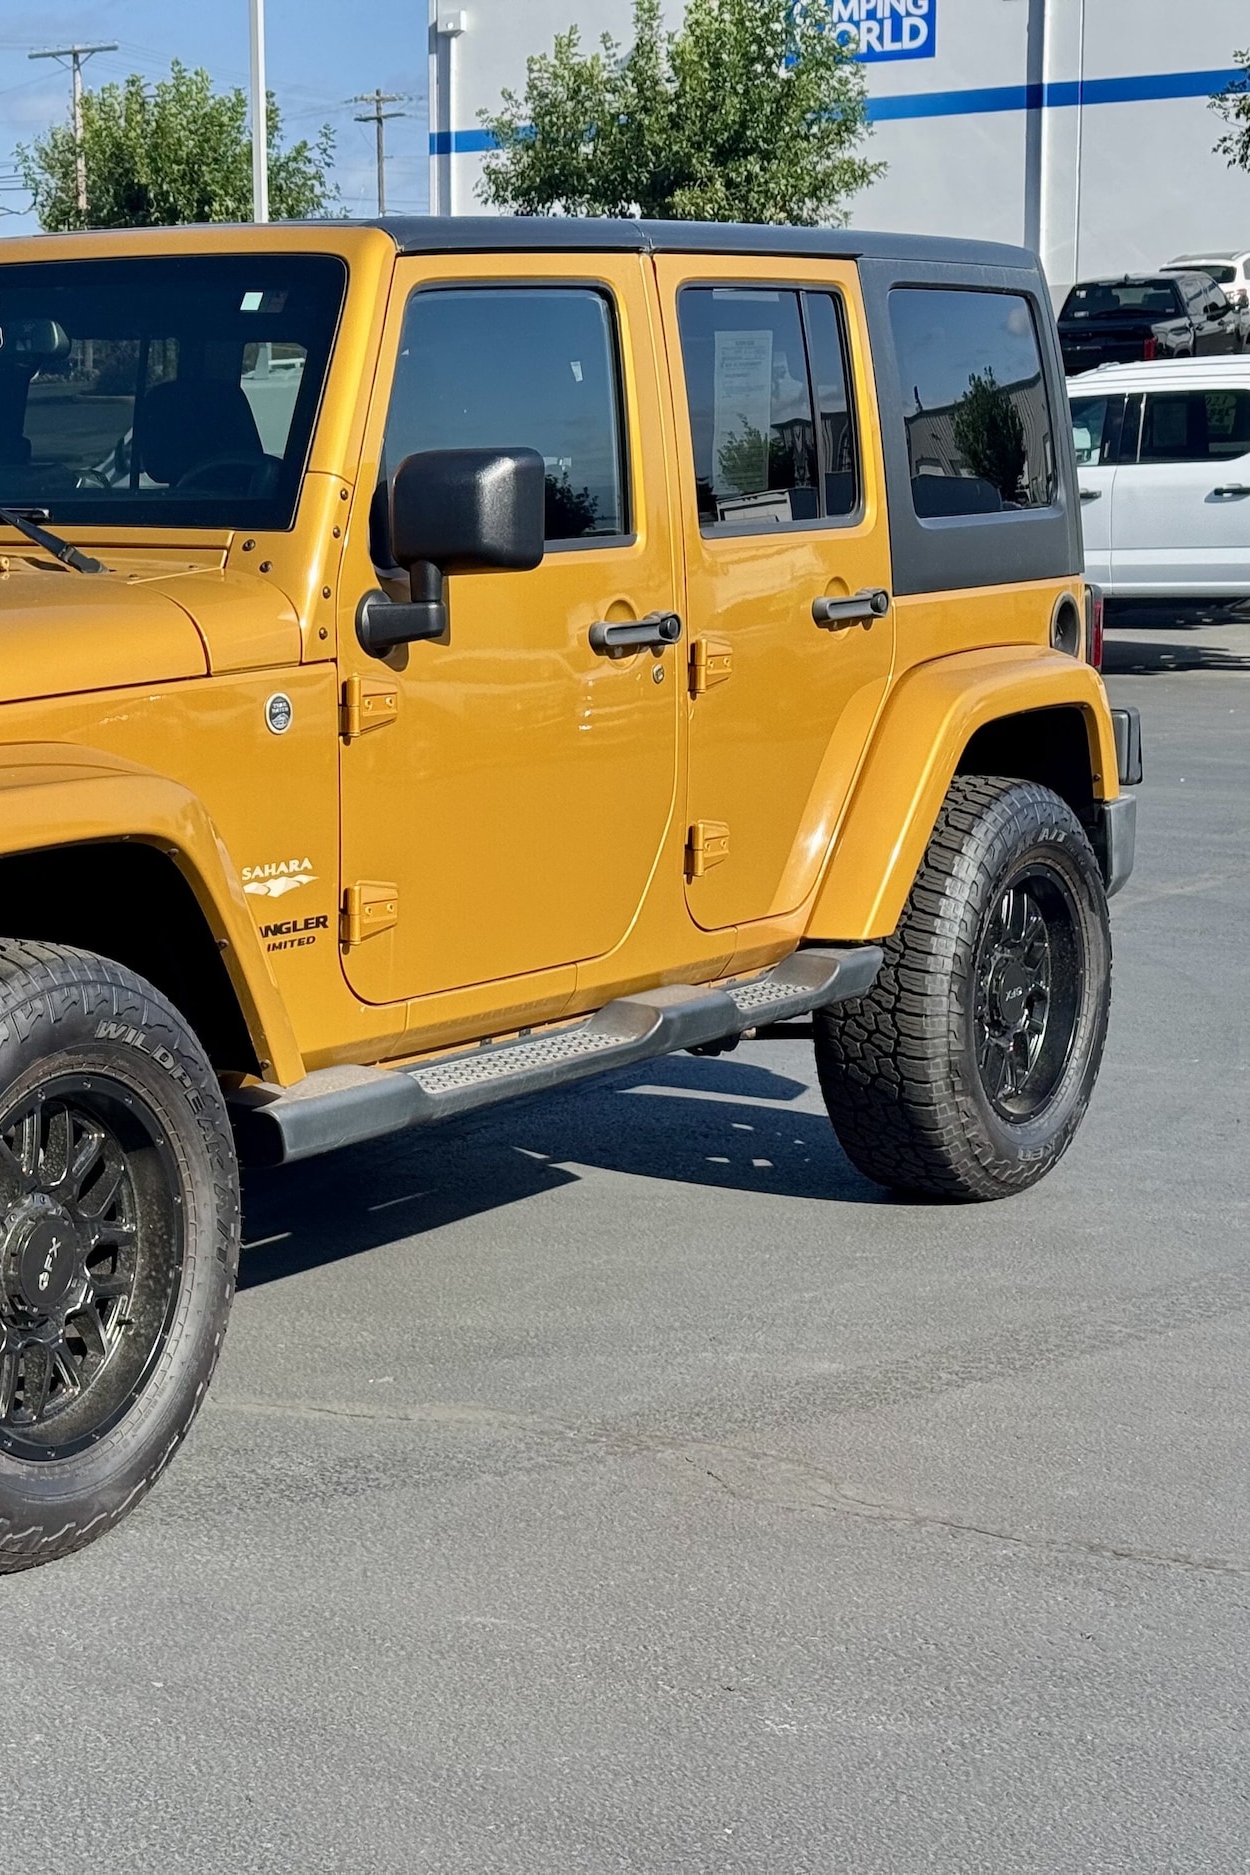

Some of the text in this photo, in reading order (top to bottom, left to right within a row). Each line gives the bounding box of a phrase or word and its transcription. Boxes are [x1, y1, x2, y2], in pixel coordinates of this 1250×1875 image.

[832, 16, 930, 53] ORLD
[241, 857, 313, 881] SAHARA
[267, 936, 317, 953] IMITED
[94, 1020, 226, 1170] WILDPEAK
[38, 1236, 62, 1291] GFX
